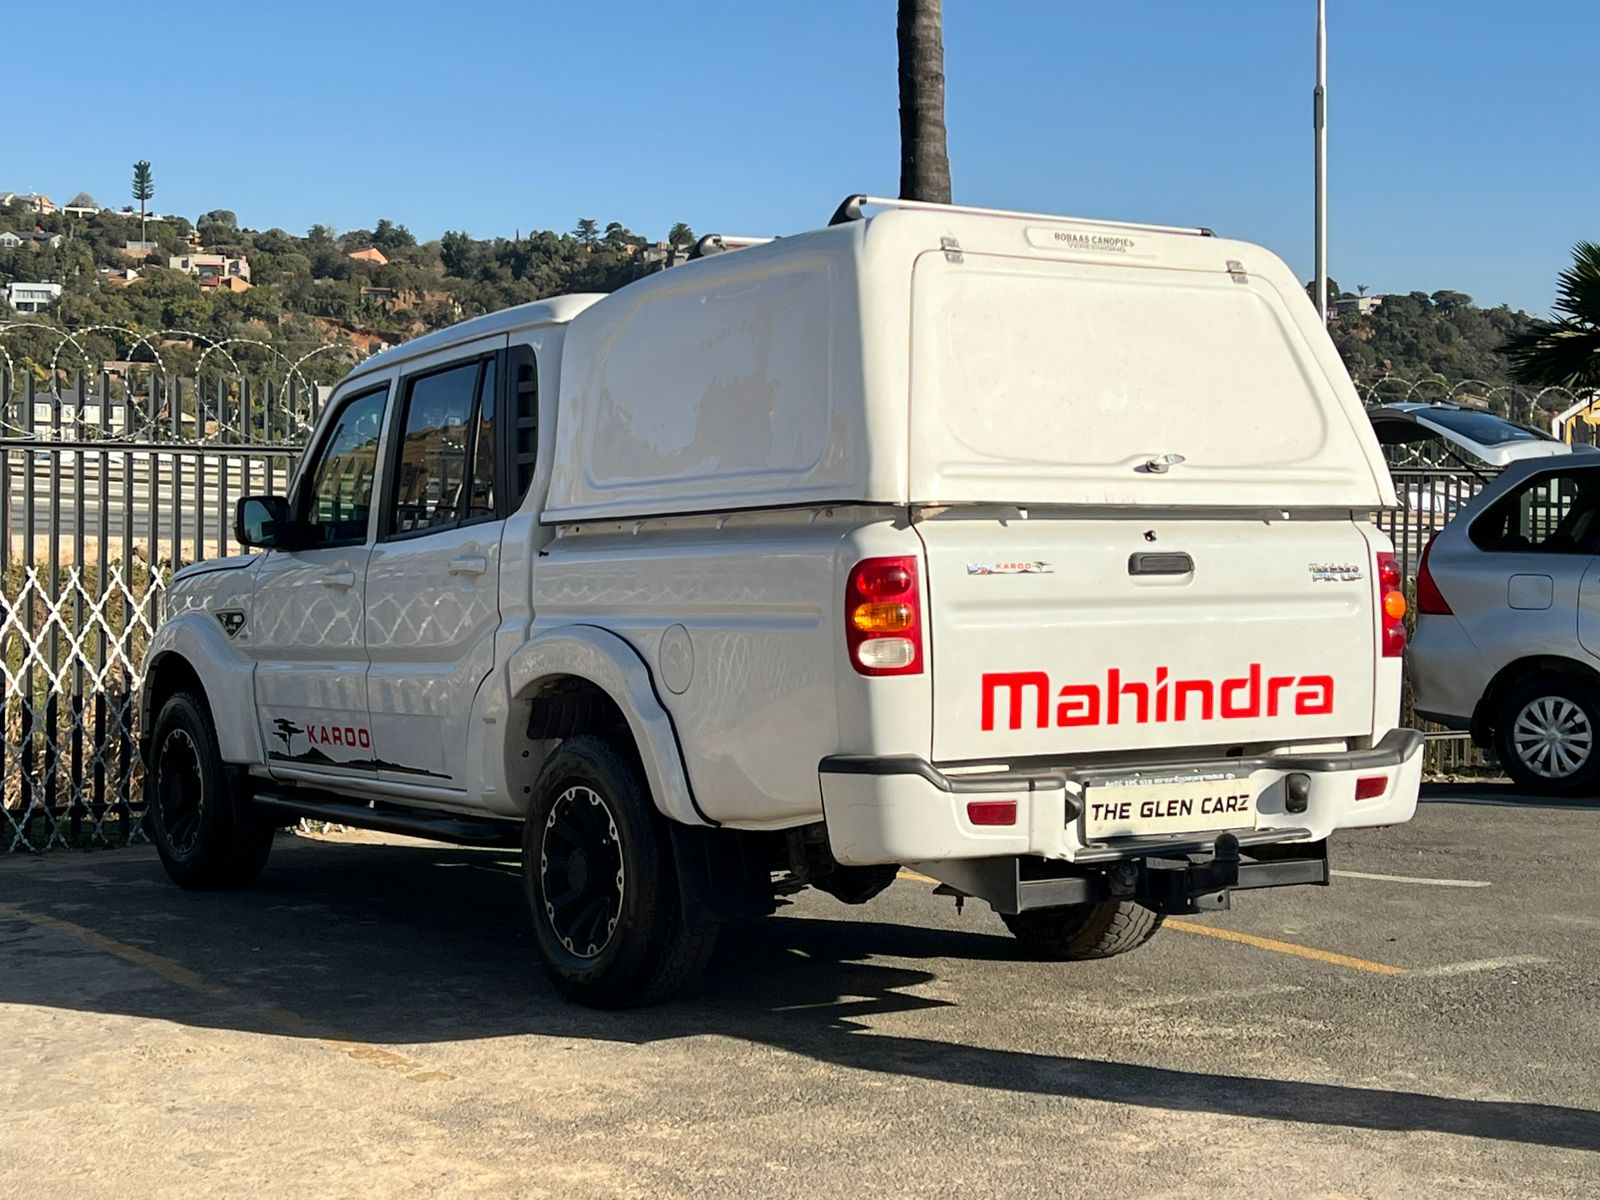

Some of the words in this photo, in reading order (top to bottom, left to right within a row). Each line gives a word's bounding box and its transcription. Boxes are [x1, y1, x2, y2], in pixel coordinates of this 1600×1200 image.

[307, 725, 371, 748] KAROO
[1091, 802, 1131, 821] THE
[1140, 799, 1193, 818] GLEN
[1201, 795, 1249, 814] CARZ
